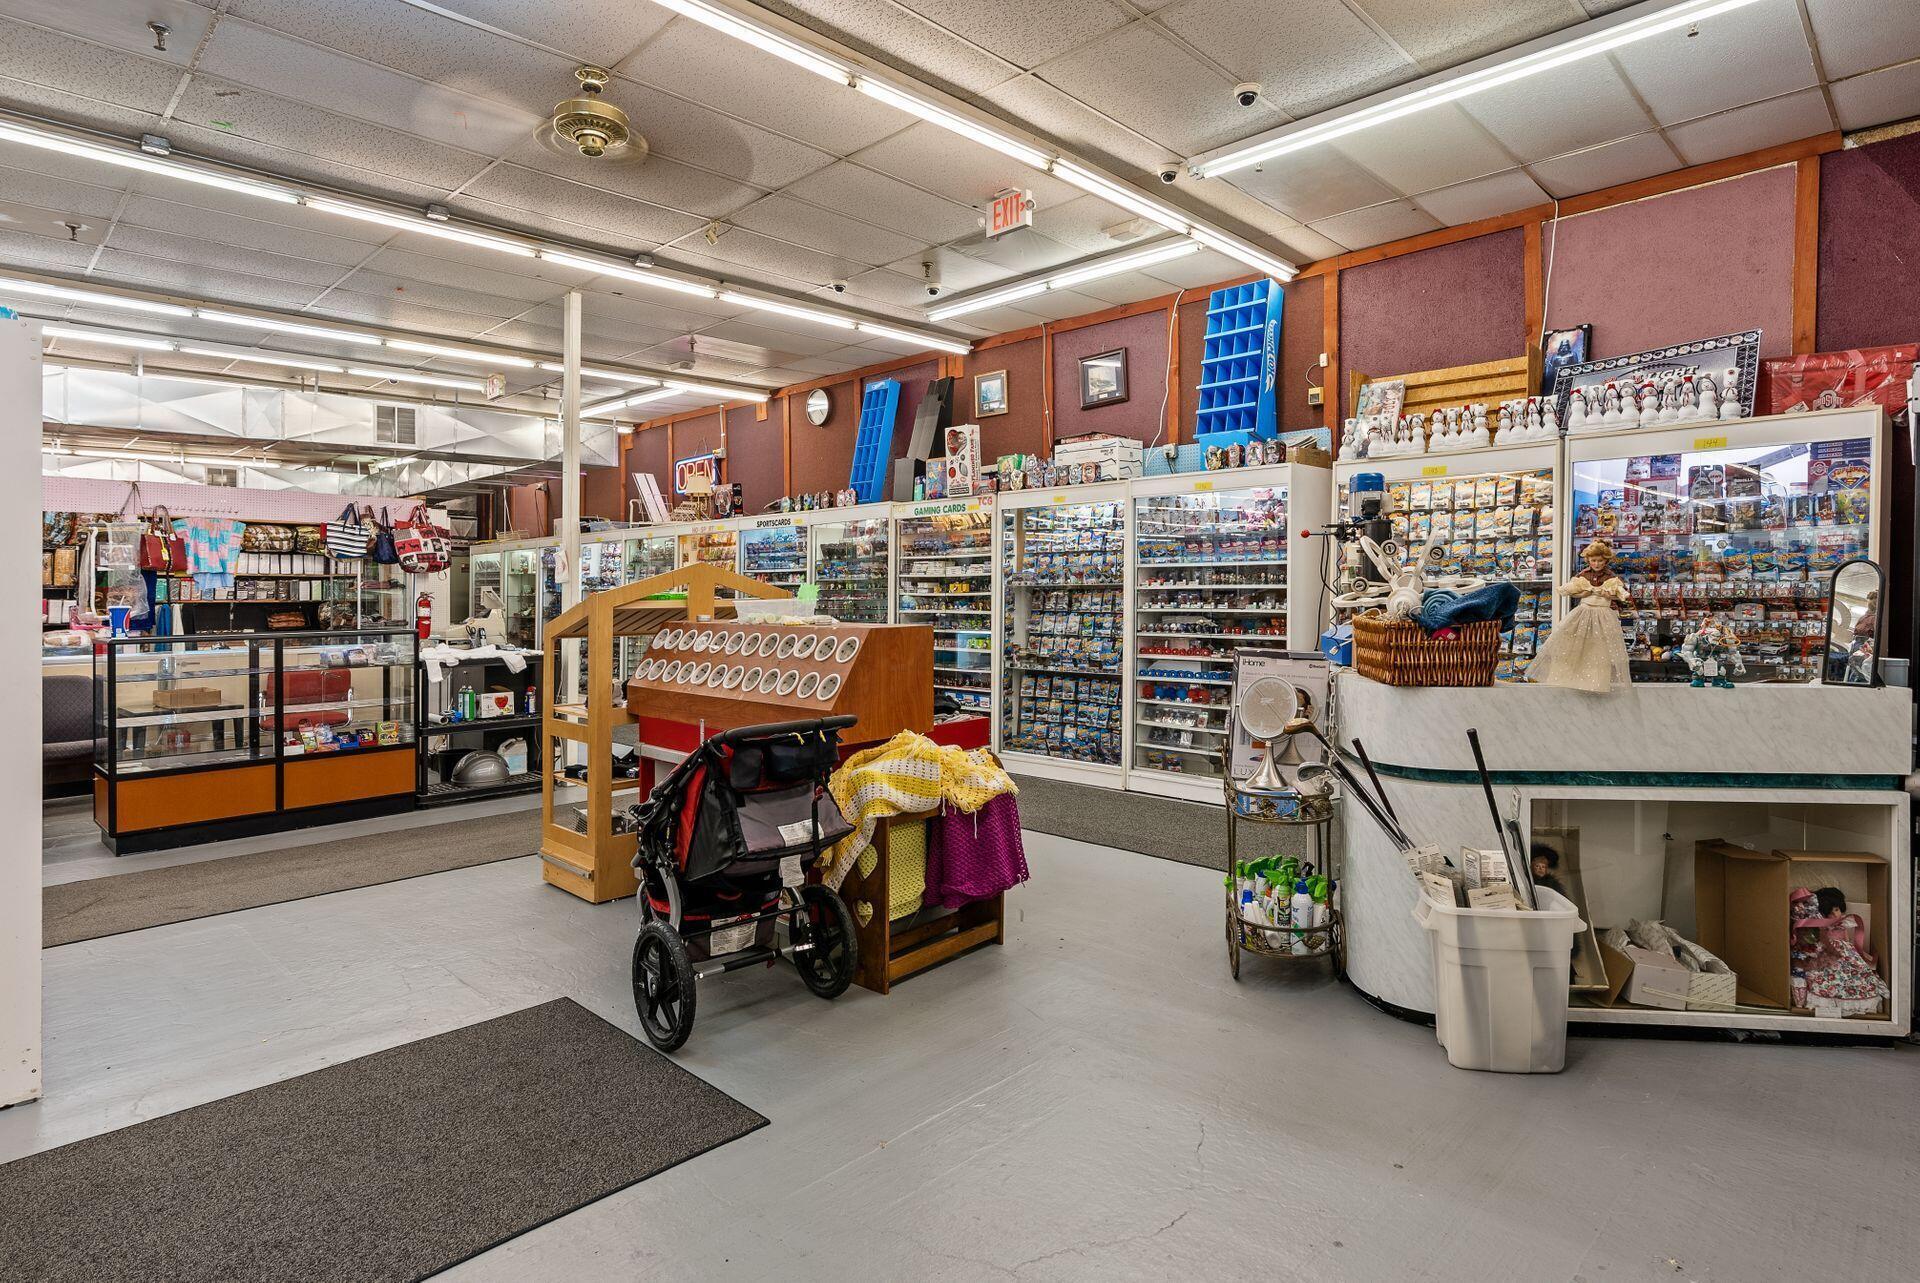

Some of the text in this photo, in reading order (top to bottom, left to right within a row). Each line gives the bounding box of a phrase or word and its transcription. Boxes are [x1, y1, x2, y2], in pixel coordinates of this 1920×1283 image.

[993, 193, 1022, 231] EXIT
[678, 460, 714, 490] OPEN
[977, 497, 993, 505] TCG
[914, 506, 941, 516] GAMING
[943, 503, 966, 513] CARDS
[756, 518, 791, 528] SPORTSCARDS
